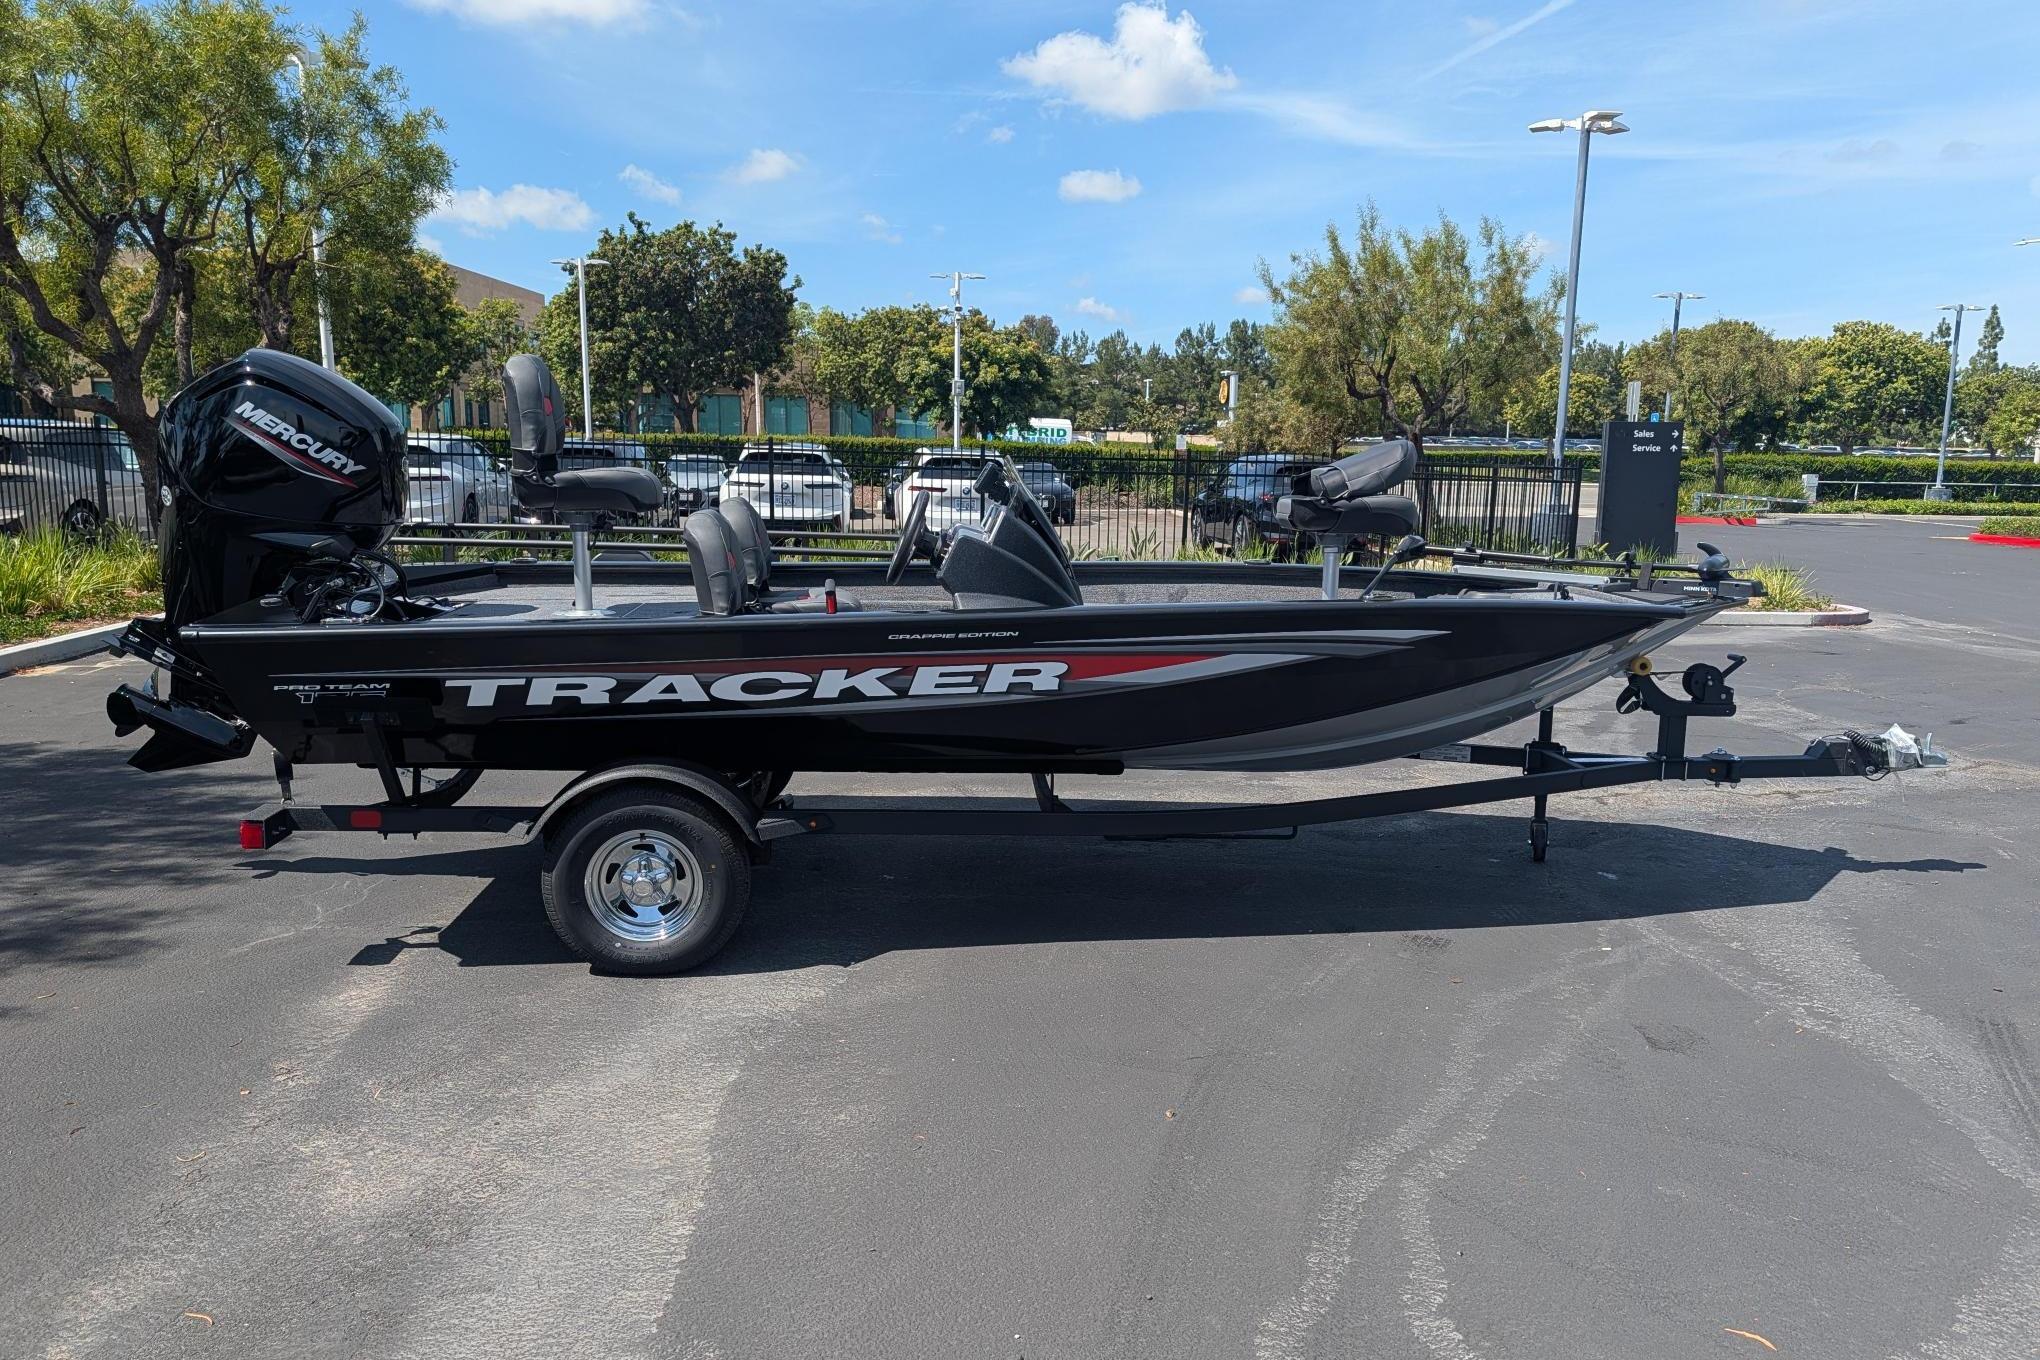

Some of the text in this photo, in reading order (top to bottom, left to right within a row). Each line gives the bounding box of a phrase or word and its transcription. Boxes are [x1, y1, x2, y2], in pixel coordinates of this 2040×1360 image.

[235, 401, 367, 475] MERCURY
[1632, 443, 1662, 452] Service
[1633, 429, 1655, 438] Sales
[444, 660, 1069, 708] TRACKER
